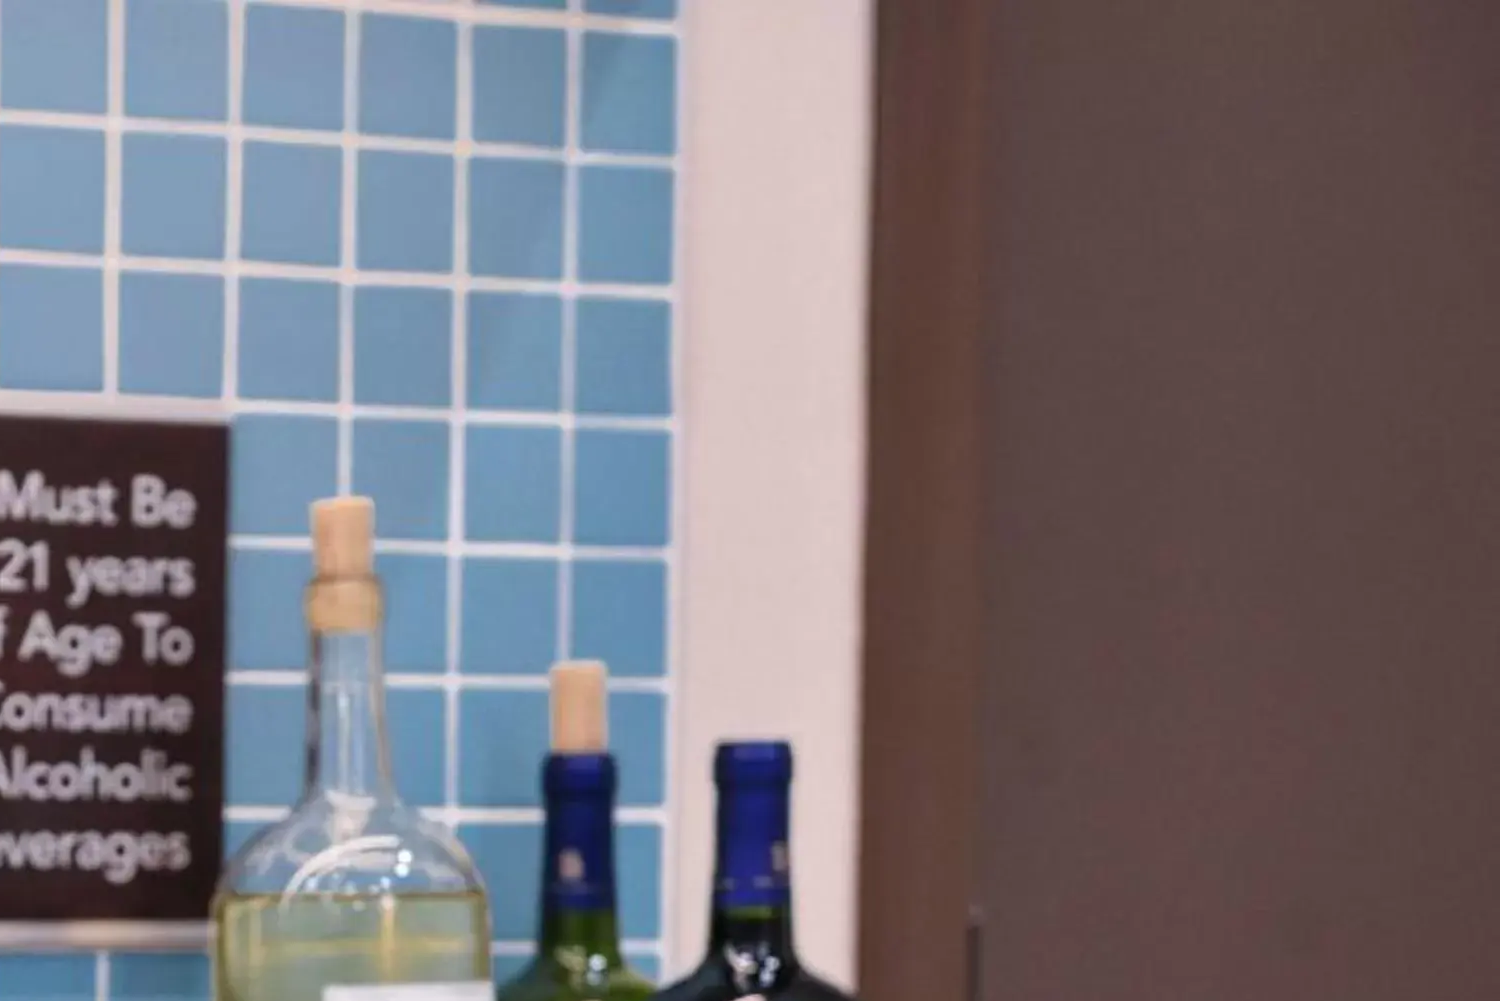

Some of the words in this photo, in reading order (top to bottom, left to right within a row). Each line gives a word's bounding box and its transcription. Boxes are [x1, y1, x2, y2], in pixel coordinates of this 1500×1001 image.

[131, 475, 197, 529] Be
[66, 553, 195, 608] years
[17, 609, 123, 677] Age
[132, 612, 194, 664] To
